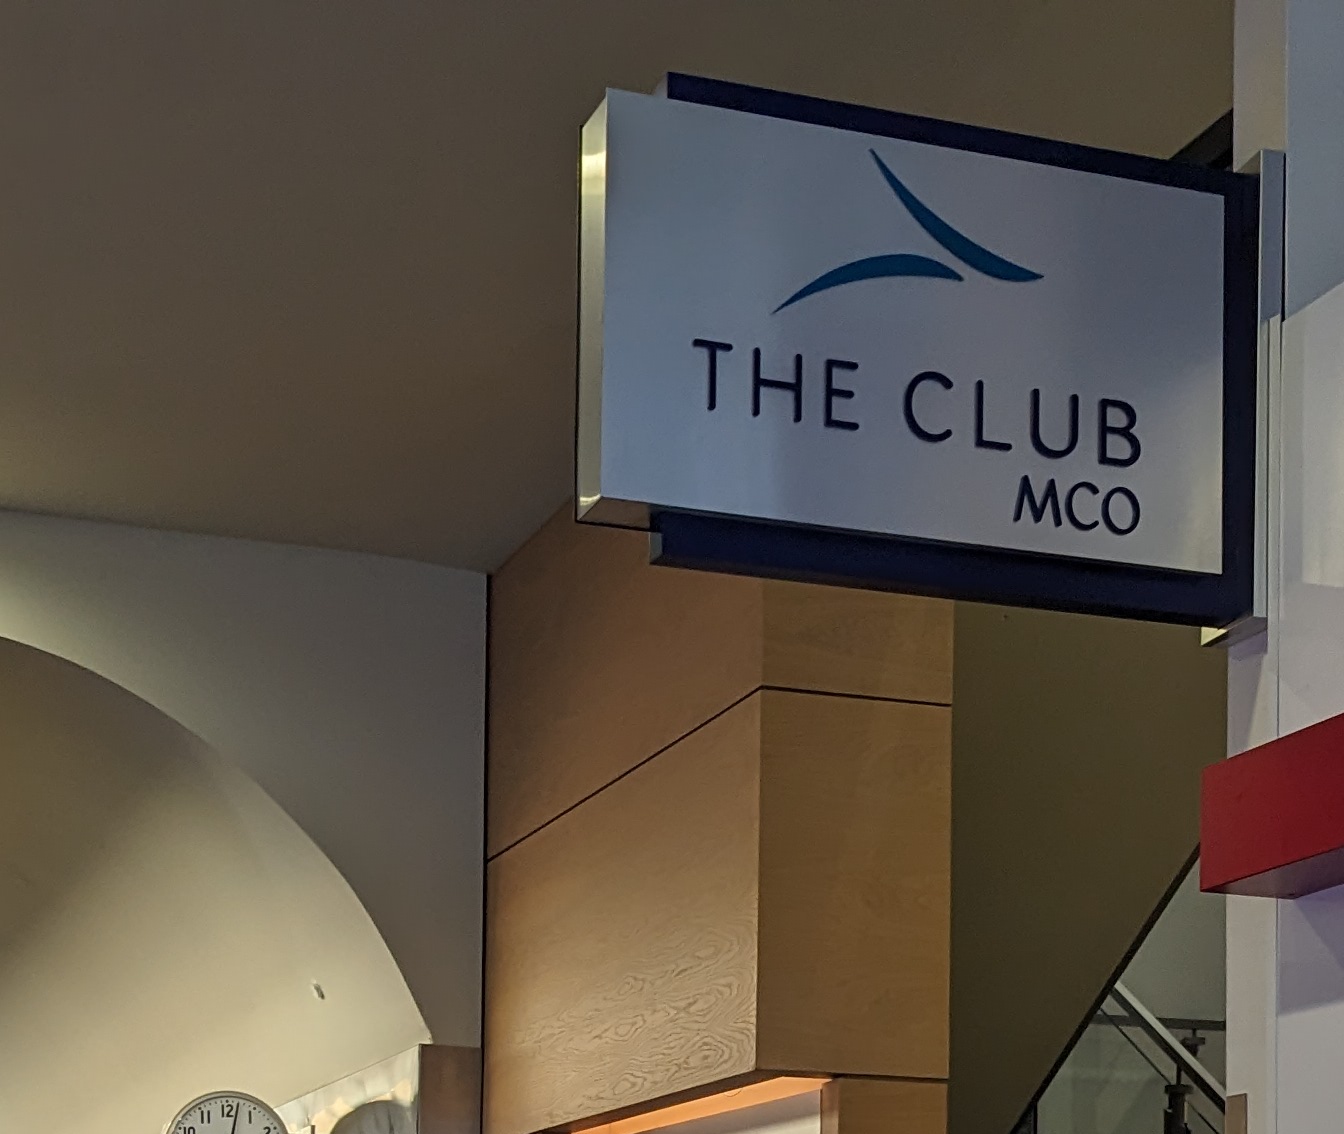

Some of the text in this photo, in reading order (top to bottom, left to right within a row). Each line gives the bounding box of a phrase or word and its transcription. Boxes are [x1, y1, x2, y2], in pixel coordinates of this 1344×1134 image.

[691, 338, 1142, 468] THE CLUB
[1012, 474, 1142, 536] MCO
[200, 1110, 211, 1124] 11
[221, 1104, 234, 1118] 12
[248, 1110, 253, 1124] 1
